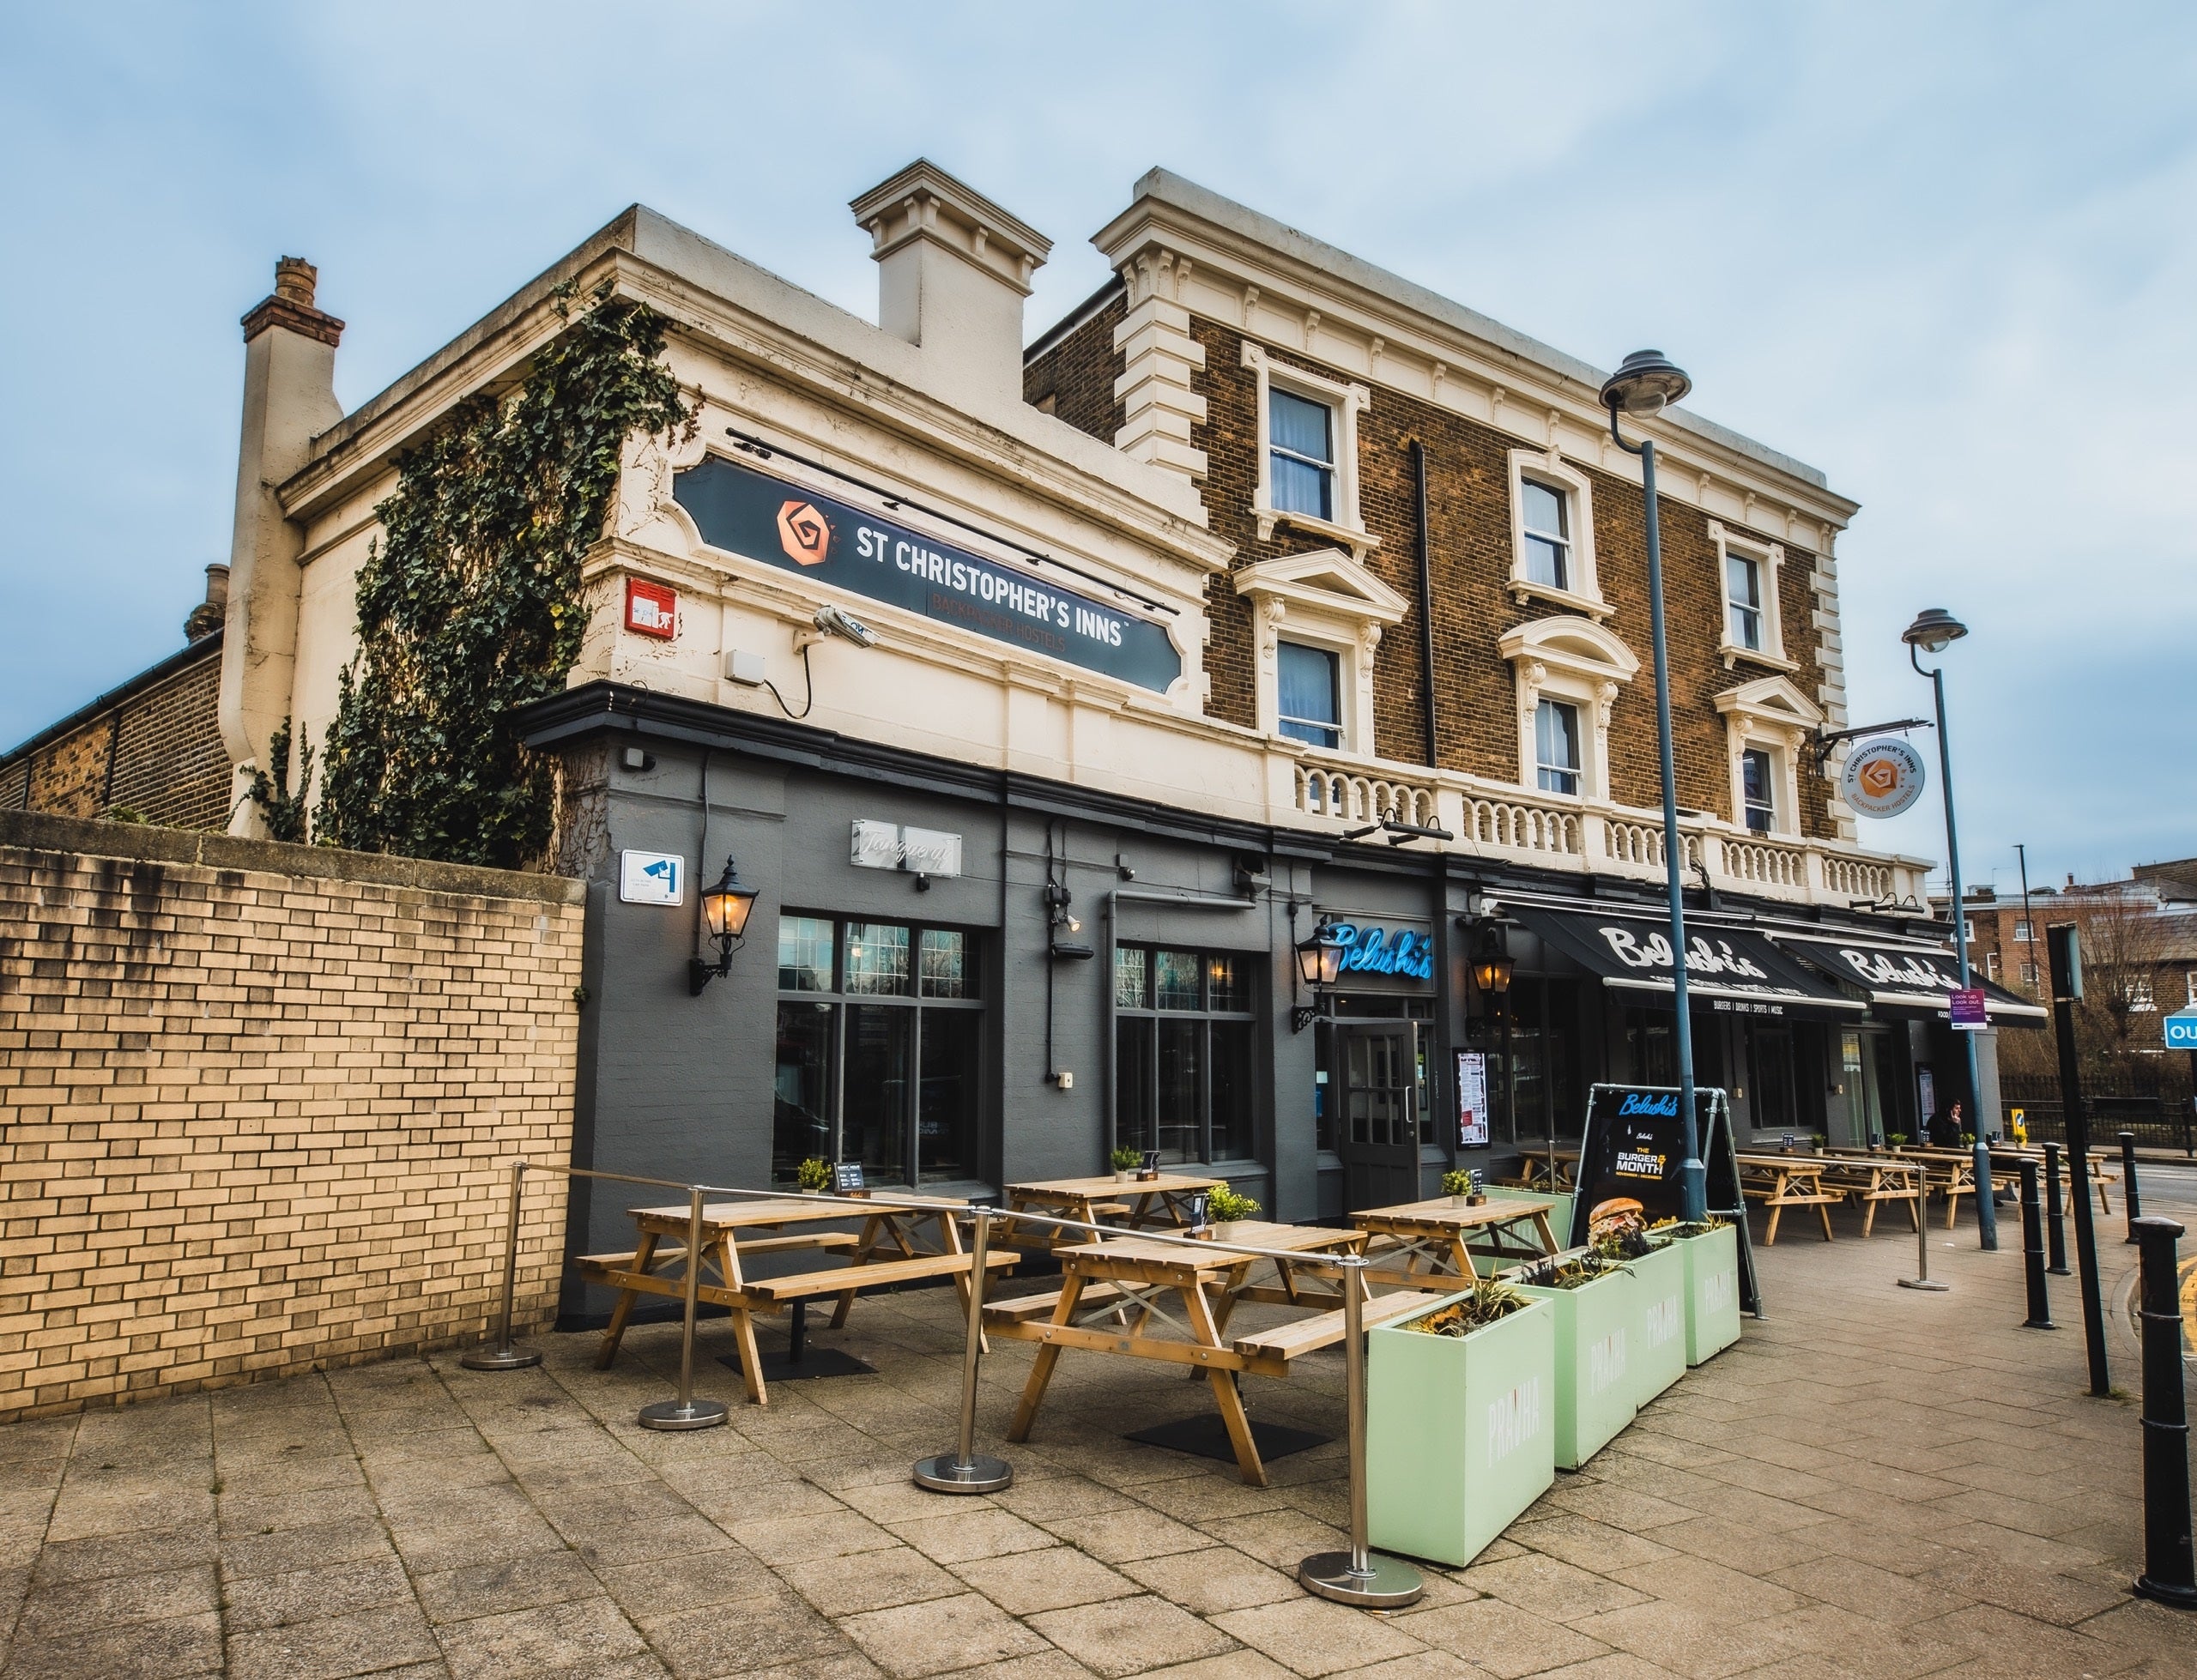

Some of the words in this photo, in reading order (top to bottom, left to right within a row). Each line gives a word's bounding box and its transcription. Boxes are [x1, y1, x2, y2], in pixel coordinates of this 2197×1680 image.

[856, 526, 889, 563] ST
[895, 541, 1070, 628] CHRISTOPHER'S
[1075, 607, 1123, 647] INNS
[932, 593, 1014, 633] BACKPACKER
[1016, 622, 1066, 653] HOSTELS
[1850, 745, 1905, 772] CHRISTOPHER'S
[1903, 754, 1917, 774] INNS
[1848, 773, 1855, 783] ST
[1851, 794, 1890, 811] BACKPACKER
[1891, 784, 1916, 808] HOSTELS
[1713, 1000, 1732, 1011] BURGERS
[1735, 1001, 1750, 1012] DRINKS
[1752, 1004, 1768, 1014] SPORTS
[1770, 1005, 1783, 1015] MUSIC
[1619, 1094, 1678, 1117] Belushi's
[1616, 1160, 1663, 1175] MONTH
[1618, 1151, 1658, 1163] BURGER
[1704, 1269, 1732, 1315] PRAVHA
[1647, 1295, 1678, 1349] PRAVHA
[1591, 1327, 1626, 1397] PRAVHA
[1487, 1375, 1539, 1469] PRAVHA
